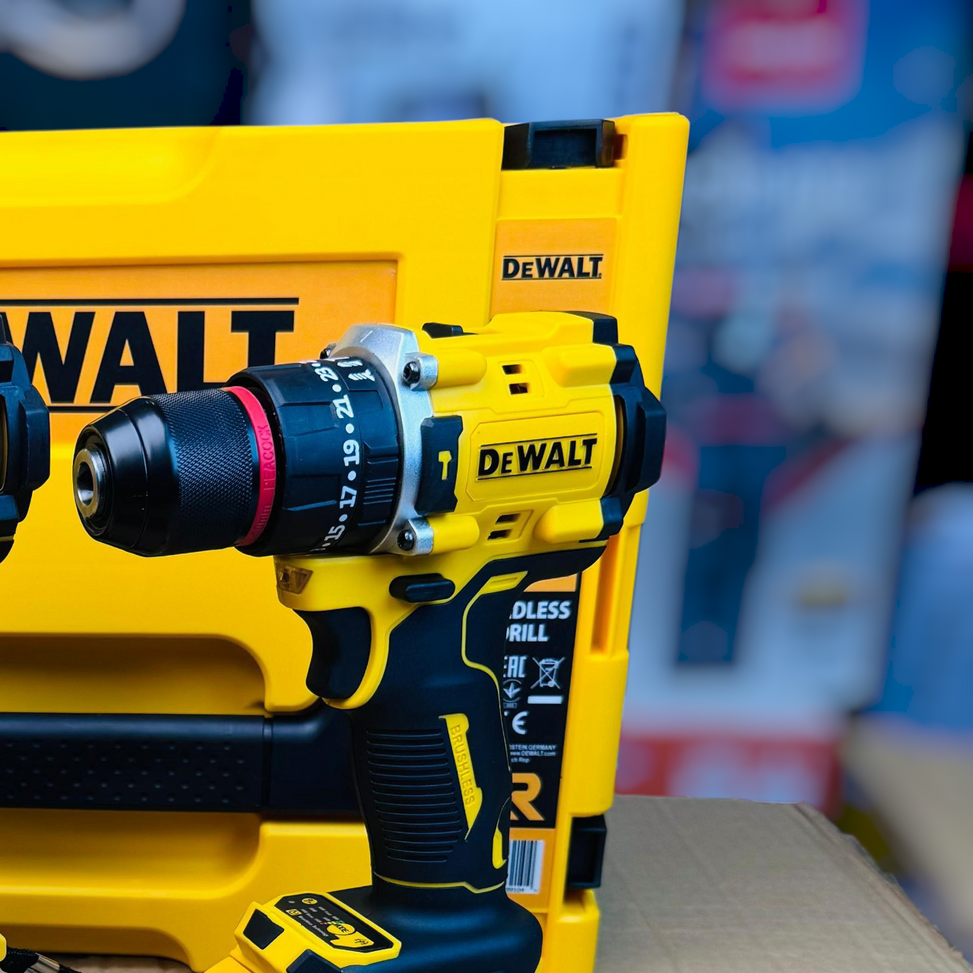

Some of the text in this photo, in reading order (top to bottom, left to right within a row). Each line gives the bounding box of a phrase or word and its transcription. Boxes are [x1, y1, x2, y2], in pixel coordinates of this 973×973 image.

[501, 255, 603, 279] DEWALT
[332, 394, 354, 419] 21
[343, 440, 360, 467] 19
[477, 438, 598, 477] DEWALT
[340, 486, 357, 509] 17
[324, 525, 345, 541] 15
[510, 600, 572, 620] DLESS
[506, 624, 549, 642] RILL
[450, 724, 476, 806] BRUSHLESS
[510, 773, 546, 821] R
